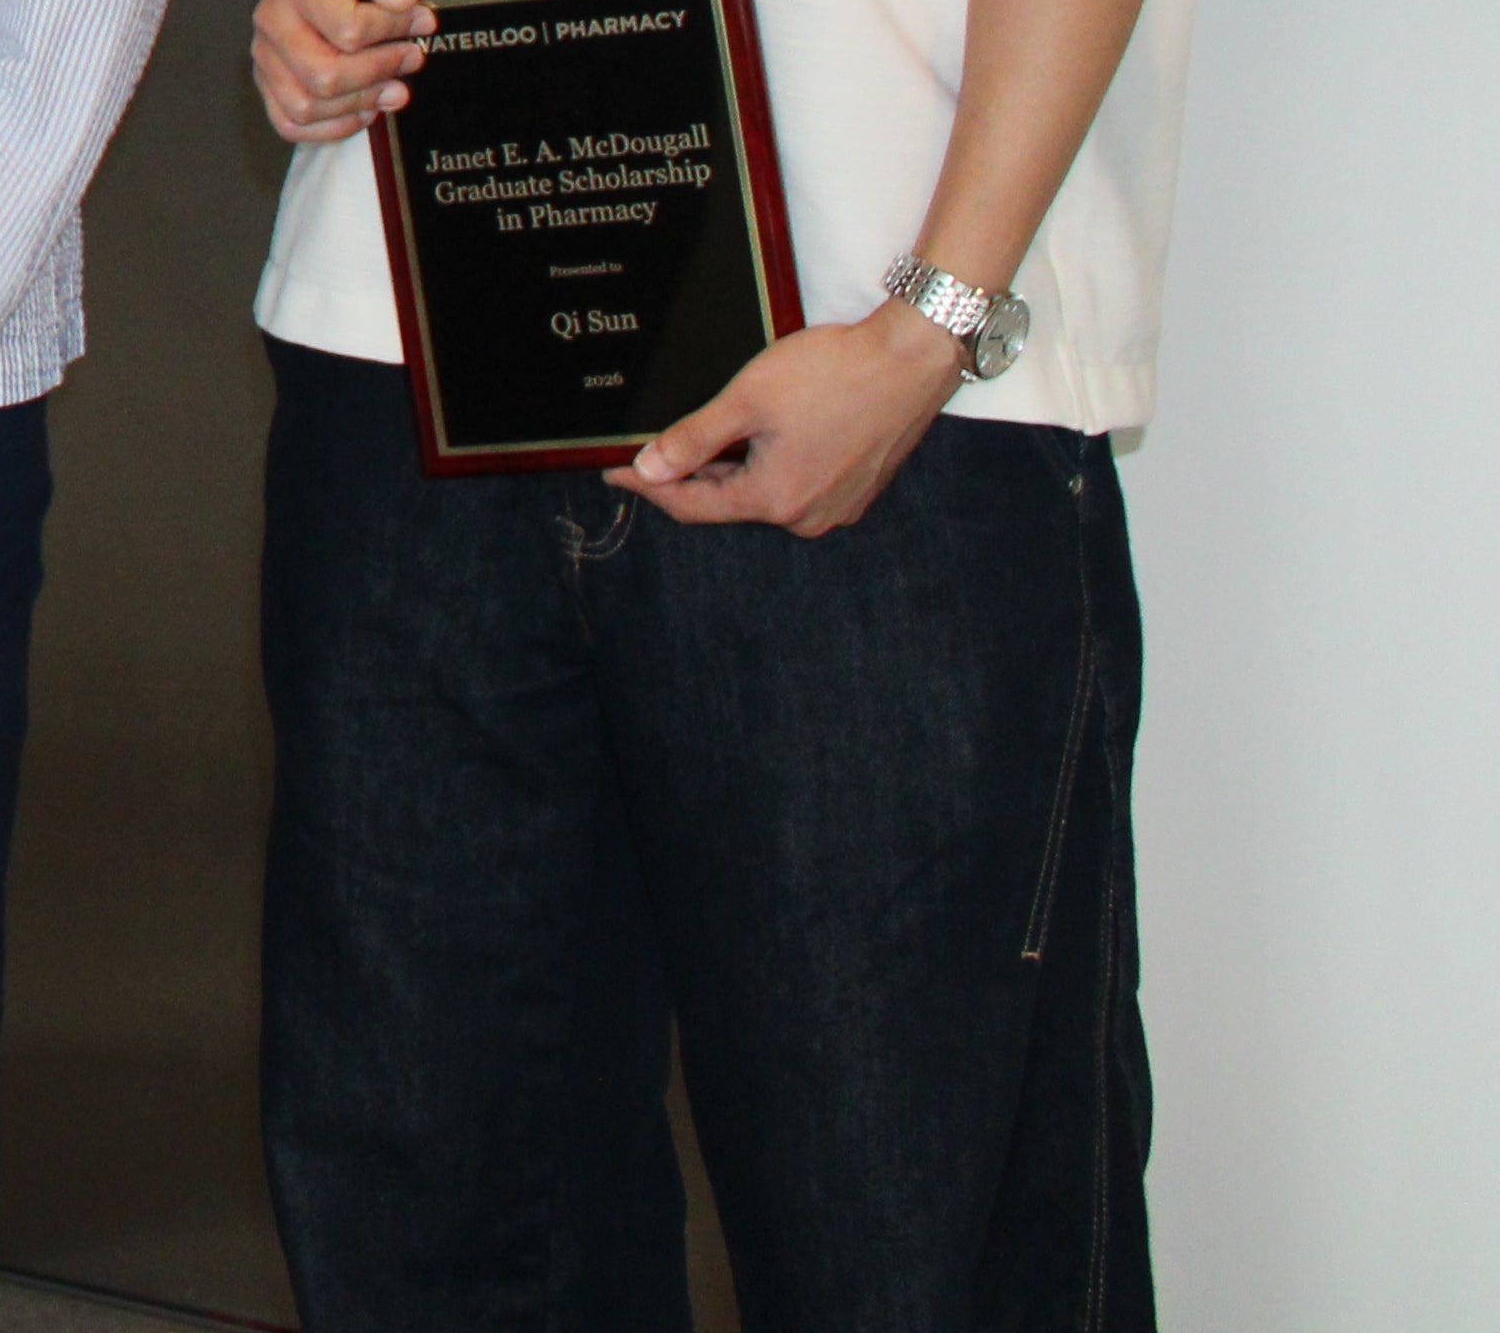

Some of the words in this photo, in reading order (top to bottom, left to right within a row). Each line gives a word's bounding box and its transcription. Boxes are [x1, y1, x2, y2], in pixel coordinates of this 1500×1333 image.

[556, 10, 688, 40] PHARMACY
[425, 147, 497, 173] Janet
[502, 143, 529, 166] E.
[536, 139, 563, 163] A.
[568, 123, 712, 160] McDougall
[435, 176, 553, 205] Graduate
[559, 159, 712, 189] Scholarship
[497, 207, 524, 231] in
[530, 200, 658, 231] Pharmacy
[609, 262, 622, 273] to
[551, 311, 582, 341] Qi
[587, 309, 639, 333] Sun
[583, 371, 625, 388] 2026
